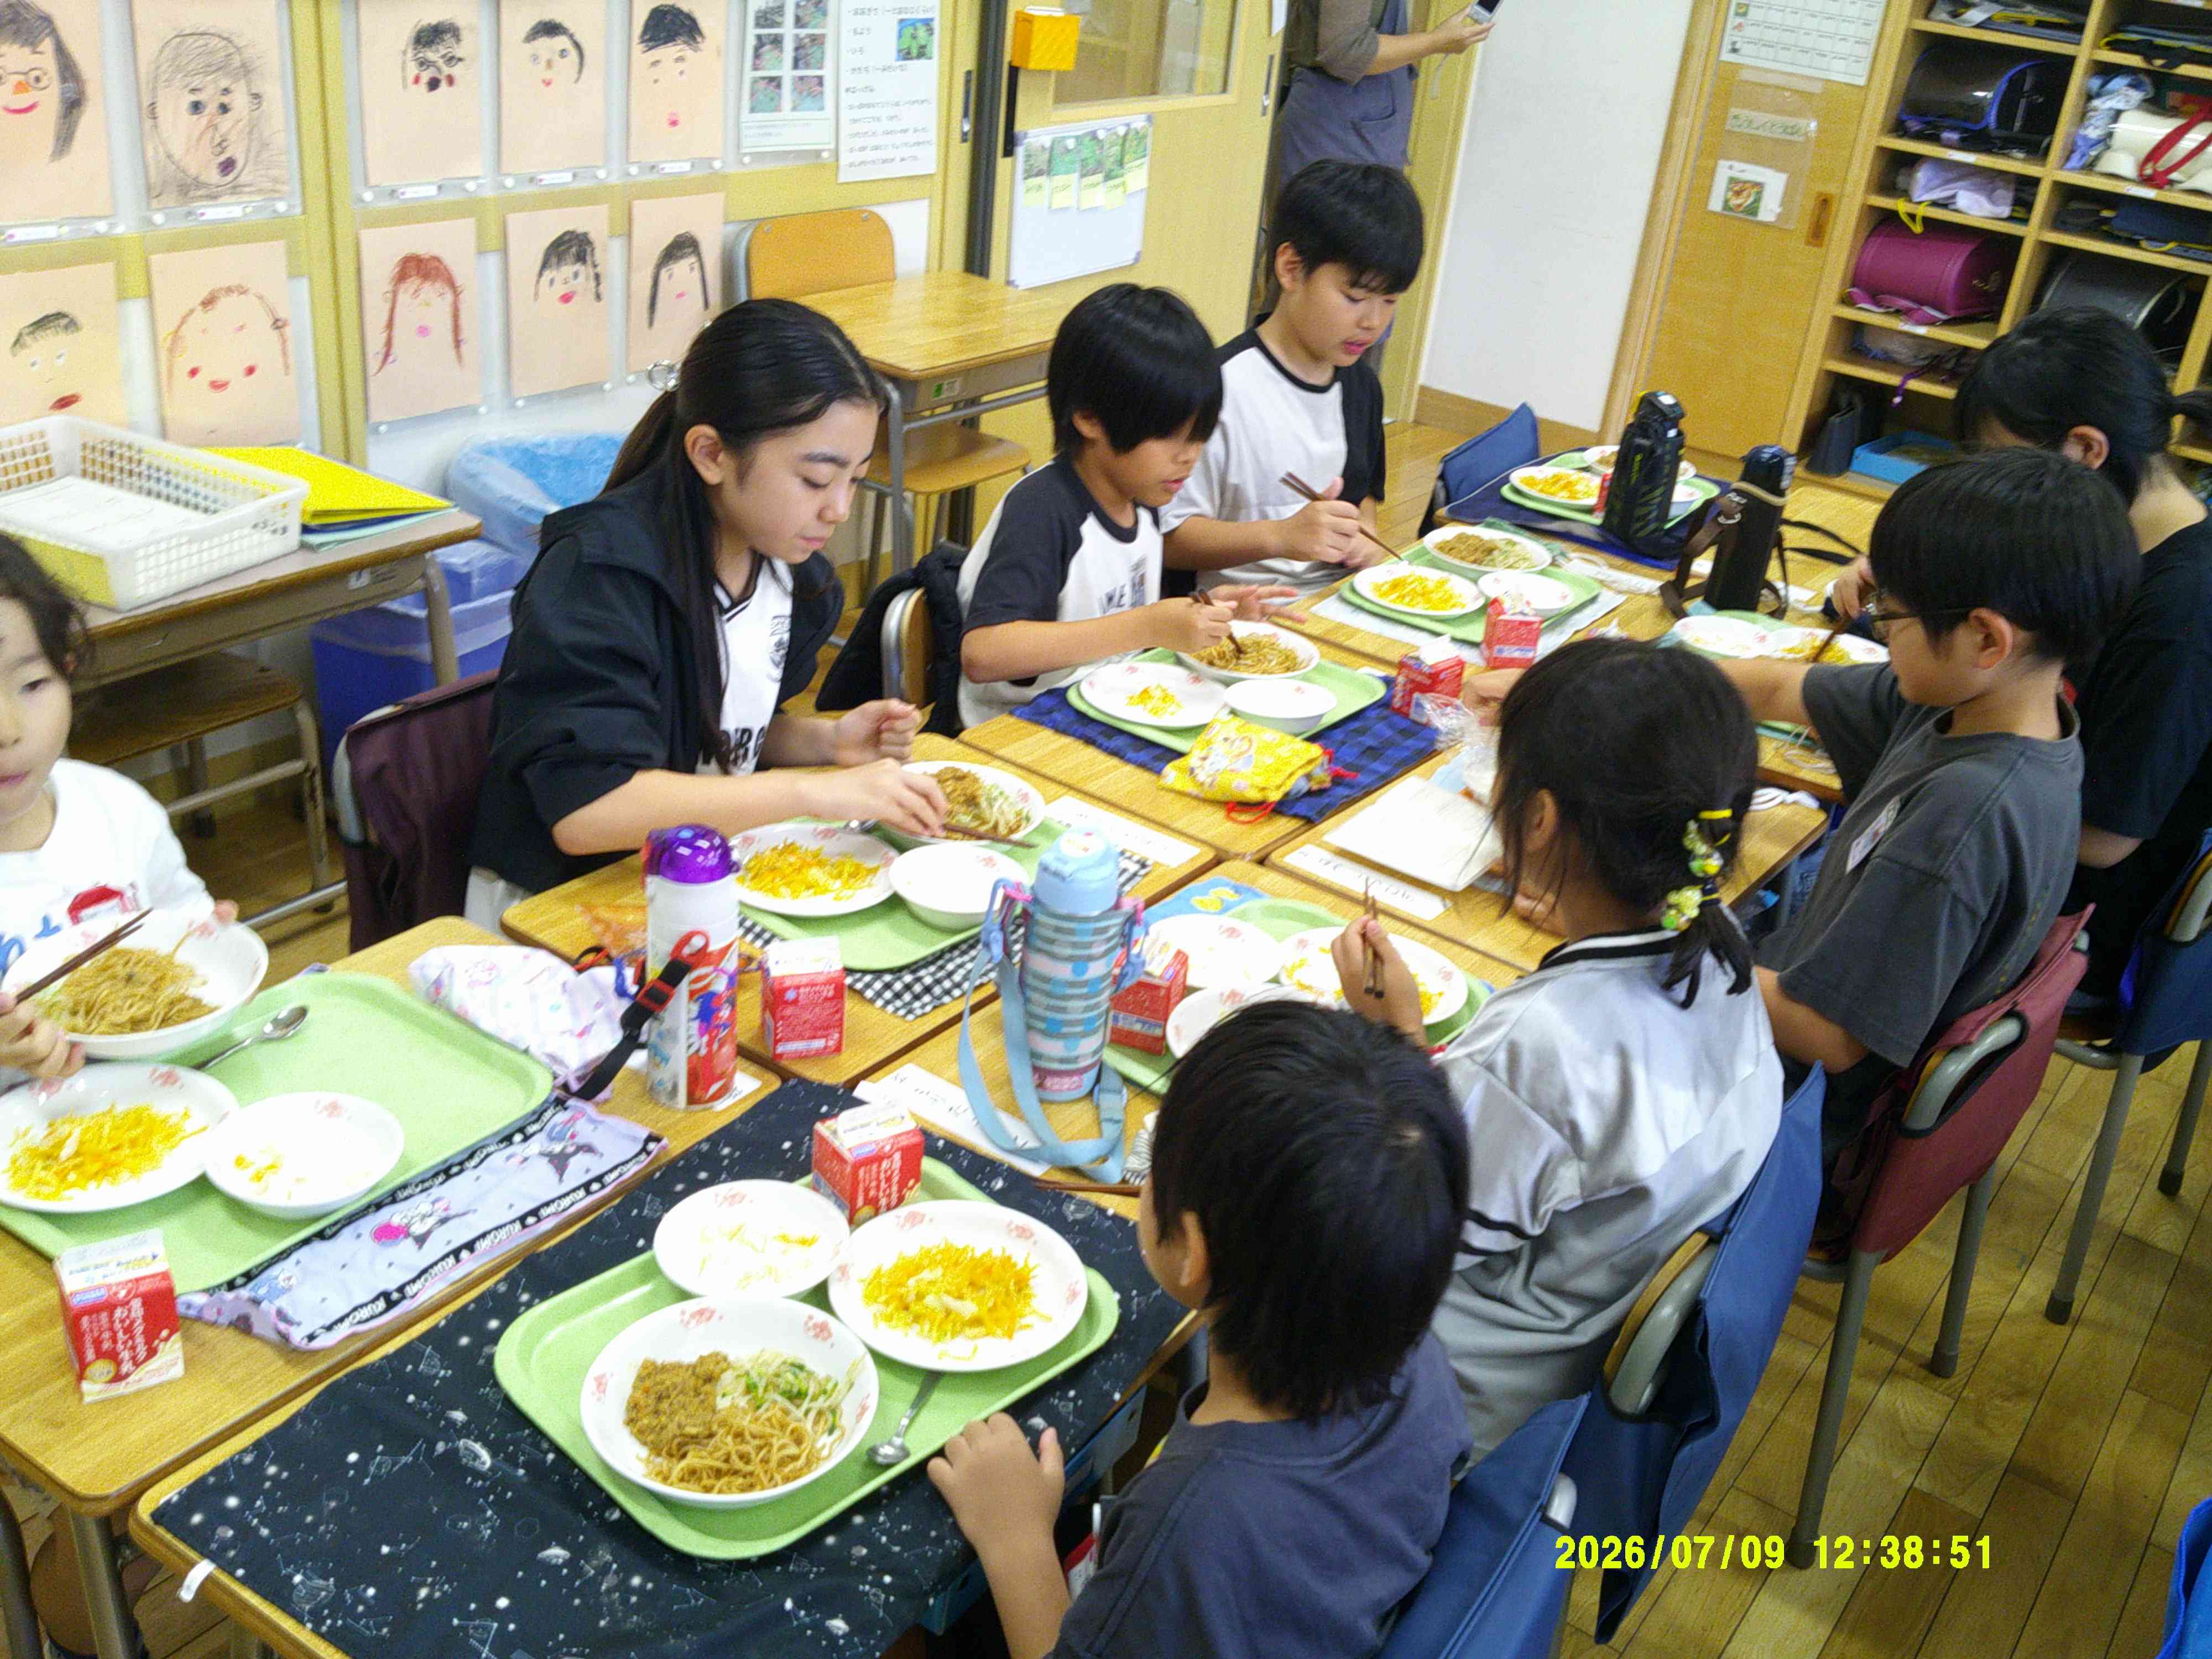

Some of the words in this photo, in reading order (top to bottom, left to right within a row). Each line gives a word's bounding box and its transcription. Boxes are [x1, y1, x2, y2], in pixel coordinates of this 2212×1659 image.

[539, 1187, 586, 1219] KUROMI
[474, 1219, 522, 1252] KUROMI
[404, 1254, 457, 1298] KUROMI
